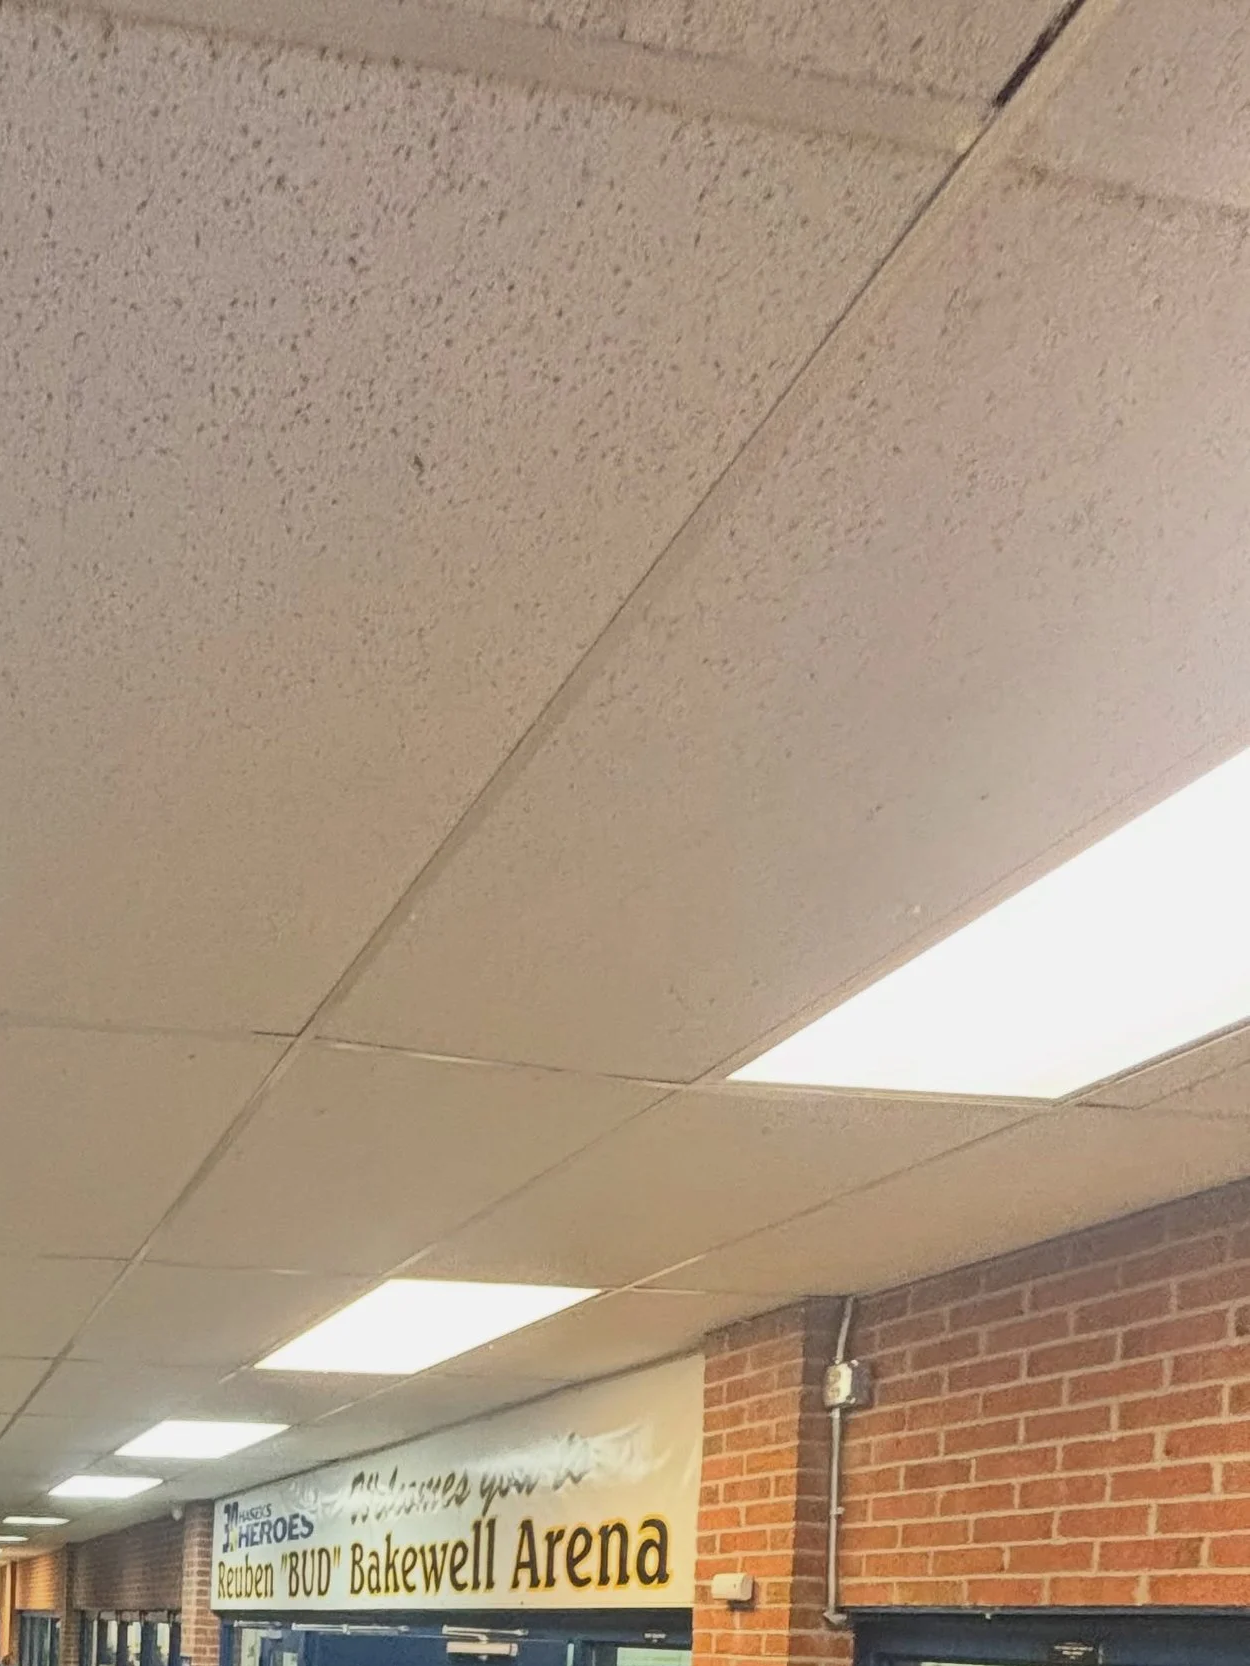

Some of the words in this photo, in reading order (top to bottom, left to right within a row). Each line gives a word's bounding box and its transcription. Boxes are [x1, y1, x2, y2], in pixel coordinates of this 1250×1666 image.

[217, 1552, 274, 1599] Reuben
[281, 1546, 341, 1598] "BUD"
[350, 1515, 496, 1596] Bakewell
[511, 1515, 671, 1591] Arena
[238, 1512, 314, 1549] HEROES
